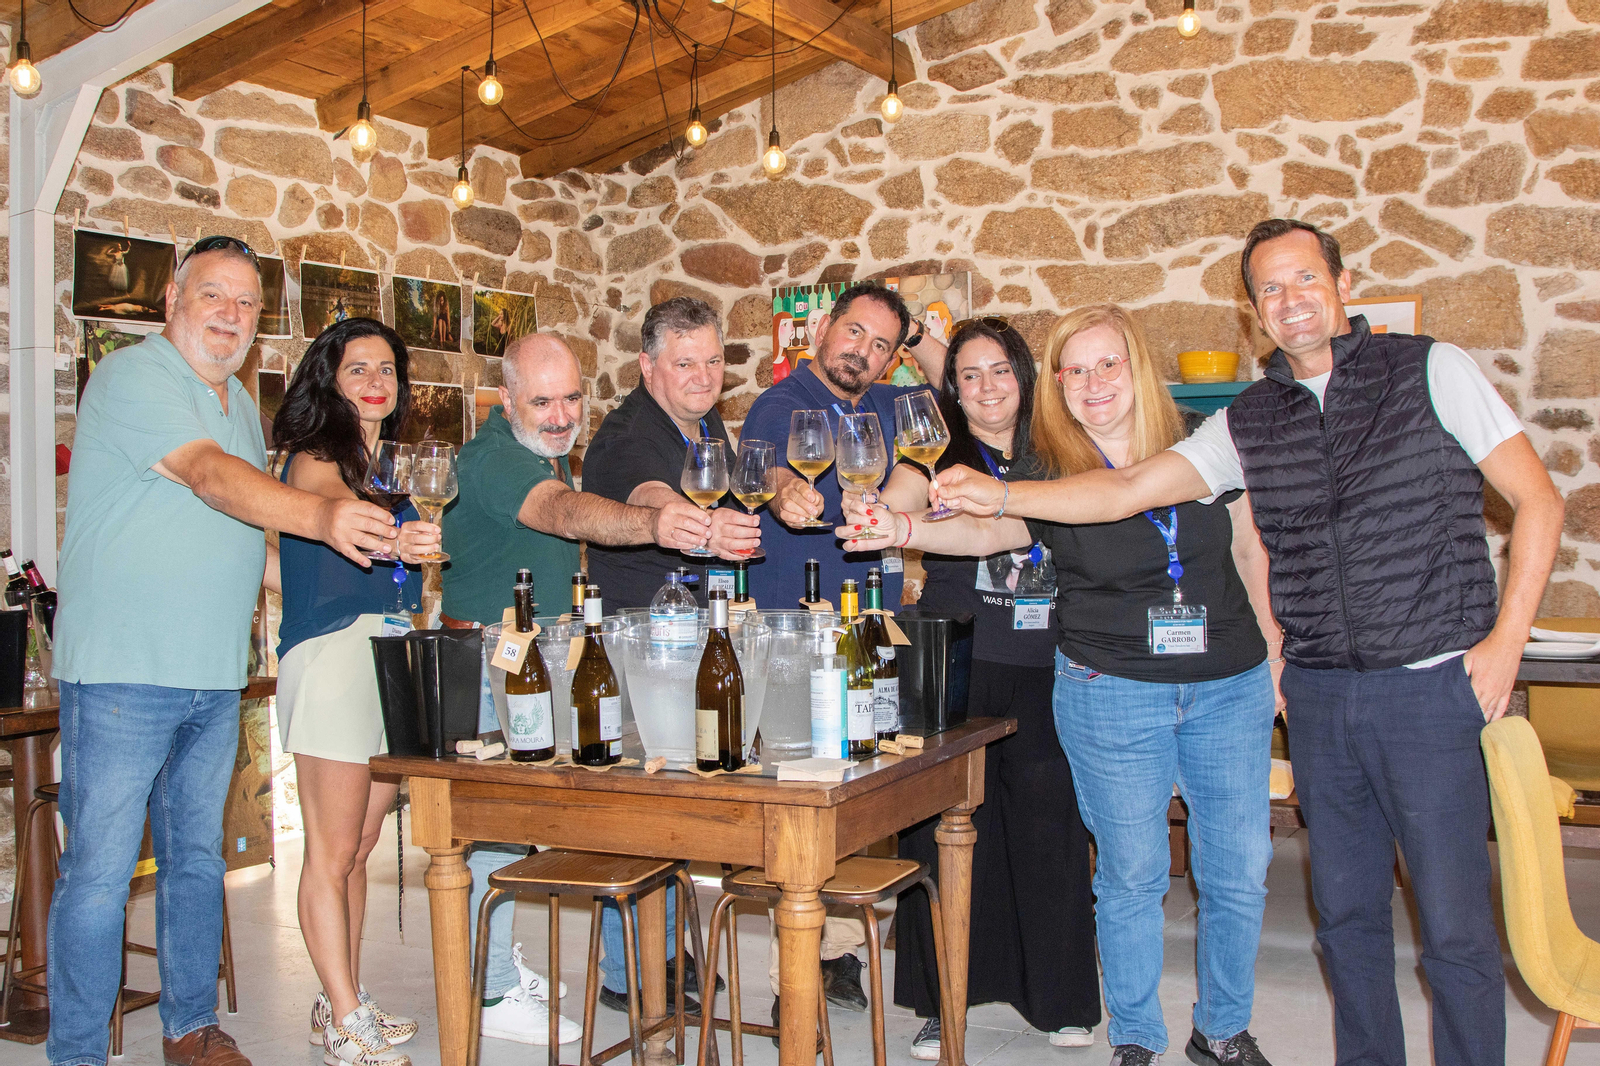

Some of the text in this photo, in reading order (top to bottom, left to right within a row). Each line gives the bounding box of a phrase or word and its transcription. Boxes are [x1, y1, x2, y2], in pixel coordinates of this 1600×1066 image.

[982, 595, 1003, 606] WAS
[1161, 635, 1197, 643] GARROBO
[504, 646, 517, 658] 58
[855, 703, 875, 713] TAP
